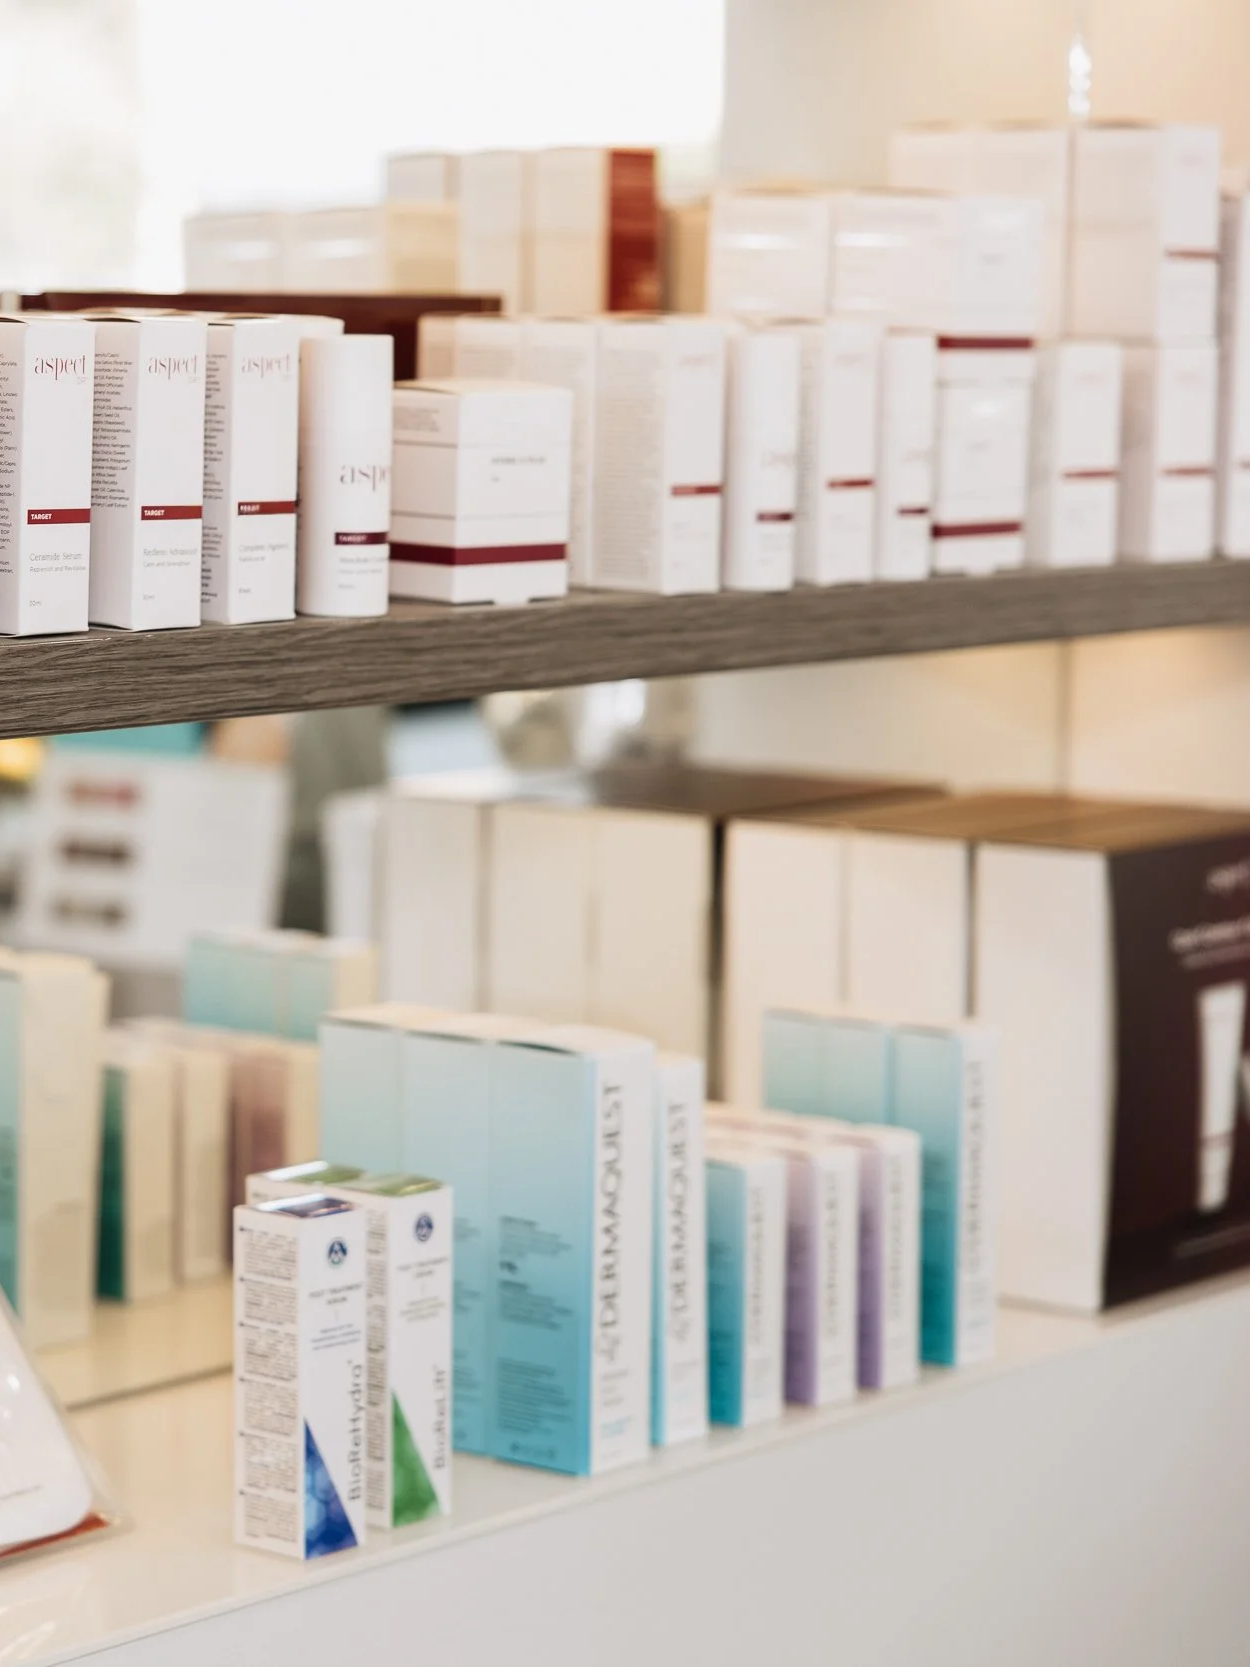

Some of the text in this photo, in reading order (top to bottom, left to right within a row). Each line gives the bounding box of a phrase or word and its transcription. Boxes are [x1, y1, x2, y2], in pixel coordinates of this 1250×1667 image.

[34, 355, 86, 381] aspect
[148, 354, 197, 380] aspect
[29, 552, 83, 561] Ceramide Serum
[598, 1081, 623, 1328] DERMAQUEST
